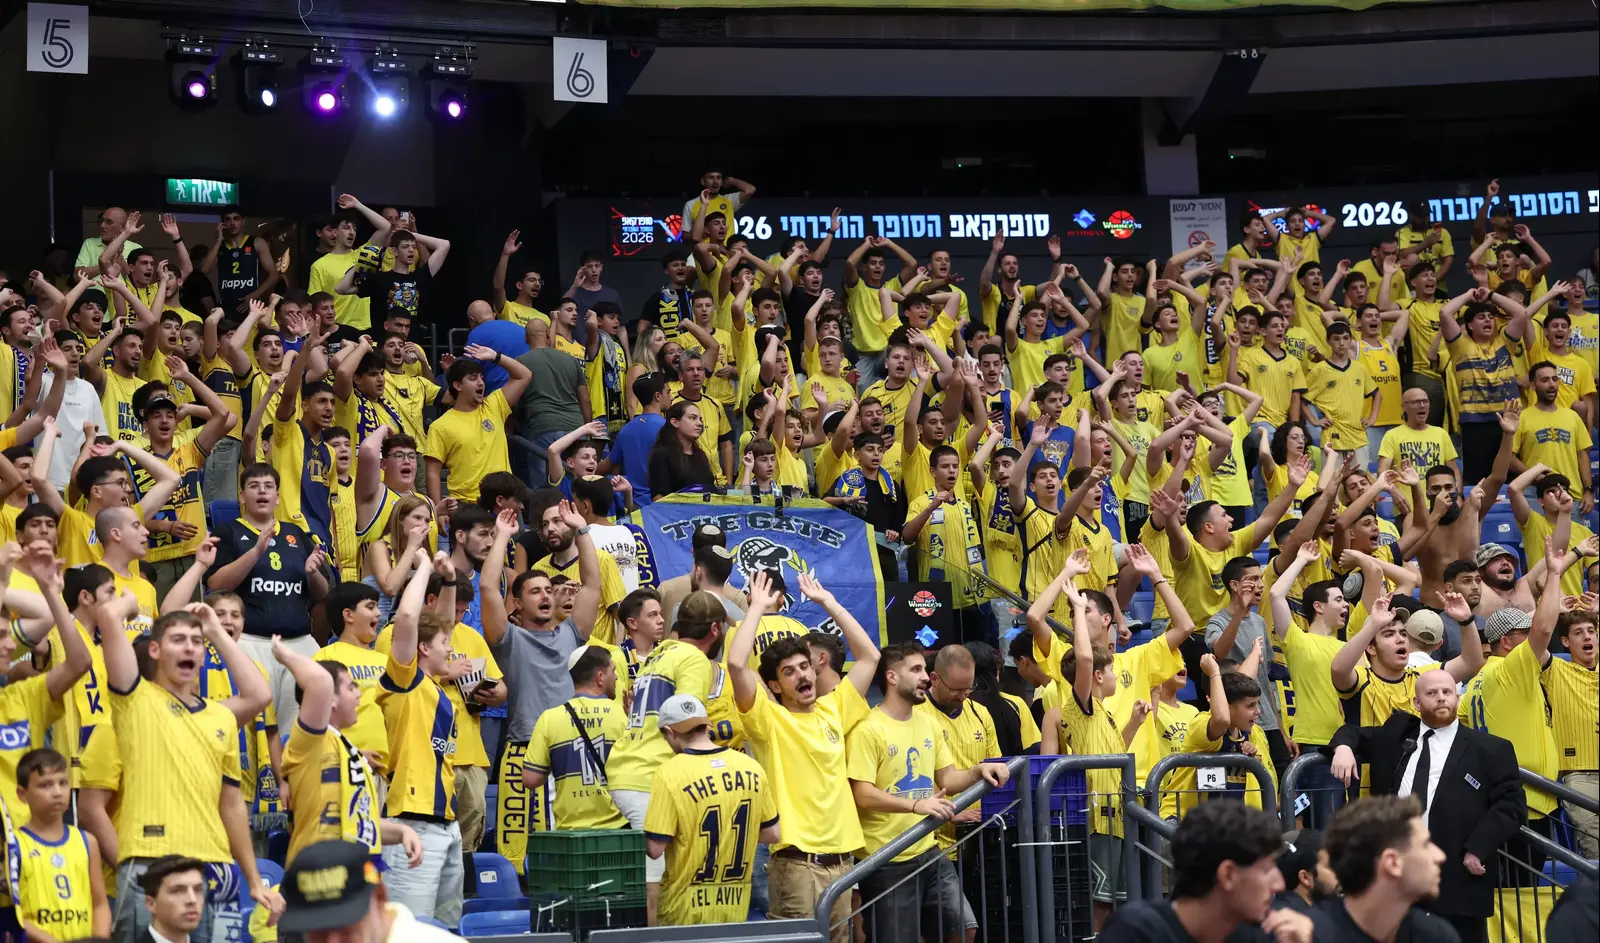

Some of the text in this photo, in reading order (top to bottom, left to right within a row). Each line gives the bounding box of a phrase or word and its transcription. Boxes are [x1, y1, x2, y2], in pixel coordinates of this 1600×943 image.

[42, 18, 74, 68] 5
[567, 52, 595, 98] 6
[191, 179, 232, 204] יציאה
[1172, 201, 1197, 215] לעשן
[1342, 201, 1408, 228] 2026
[1508, 196, 1580, 217] הסופר
[622, 232, 654, 243] 2026
[733, 216, 772, 241] 26
[872, 215, 942, 239] הסופר
[949, 213, 1050, 241] סופרקאפ
[232, 262, 240, 274] 2
[221, 278, 254, 290] Rapyd
[1379, 360, 1388, 372] 5
[1400, 441, 1440, 454] NOW I'M
[660, 511, 847, 549] THE GATE
[269, 552, 282, 571] 8
[1471, 695, 1489, 734] 11
[432, 737, 446, 752] 5G
[682, 770, 760, 804] THE GATE
[1206, 773, 1217, 783] P6
[503, 742, 528, 846] HAPOEL
[690, 798, 752, 886] 11
[55, 874, 72, 900] 9
[715, 886, 743, 906] AVIV
